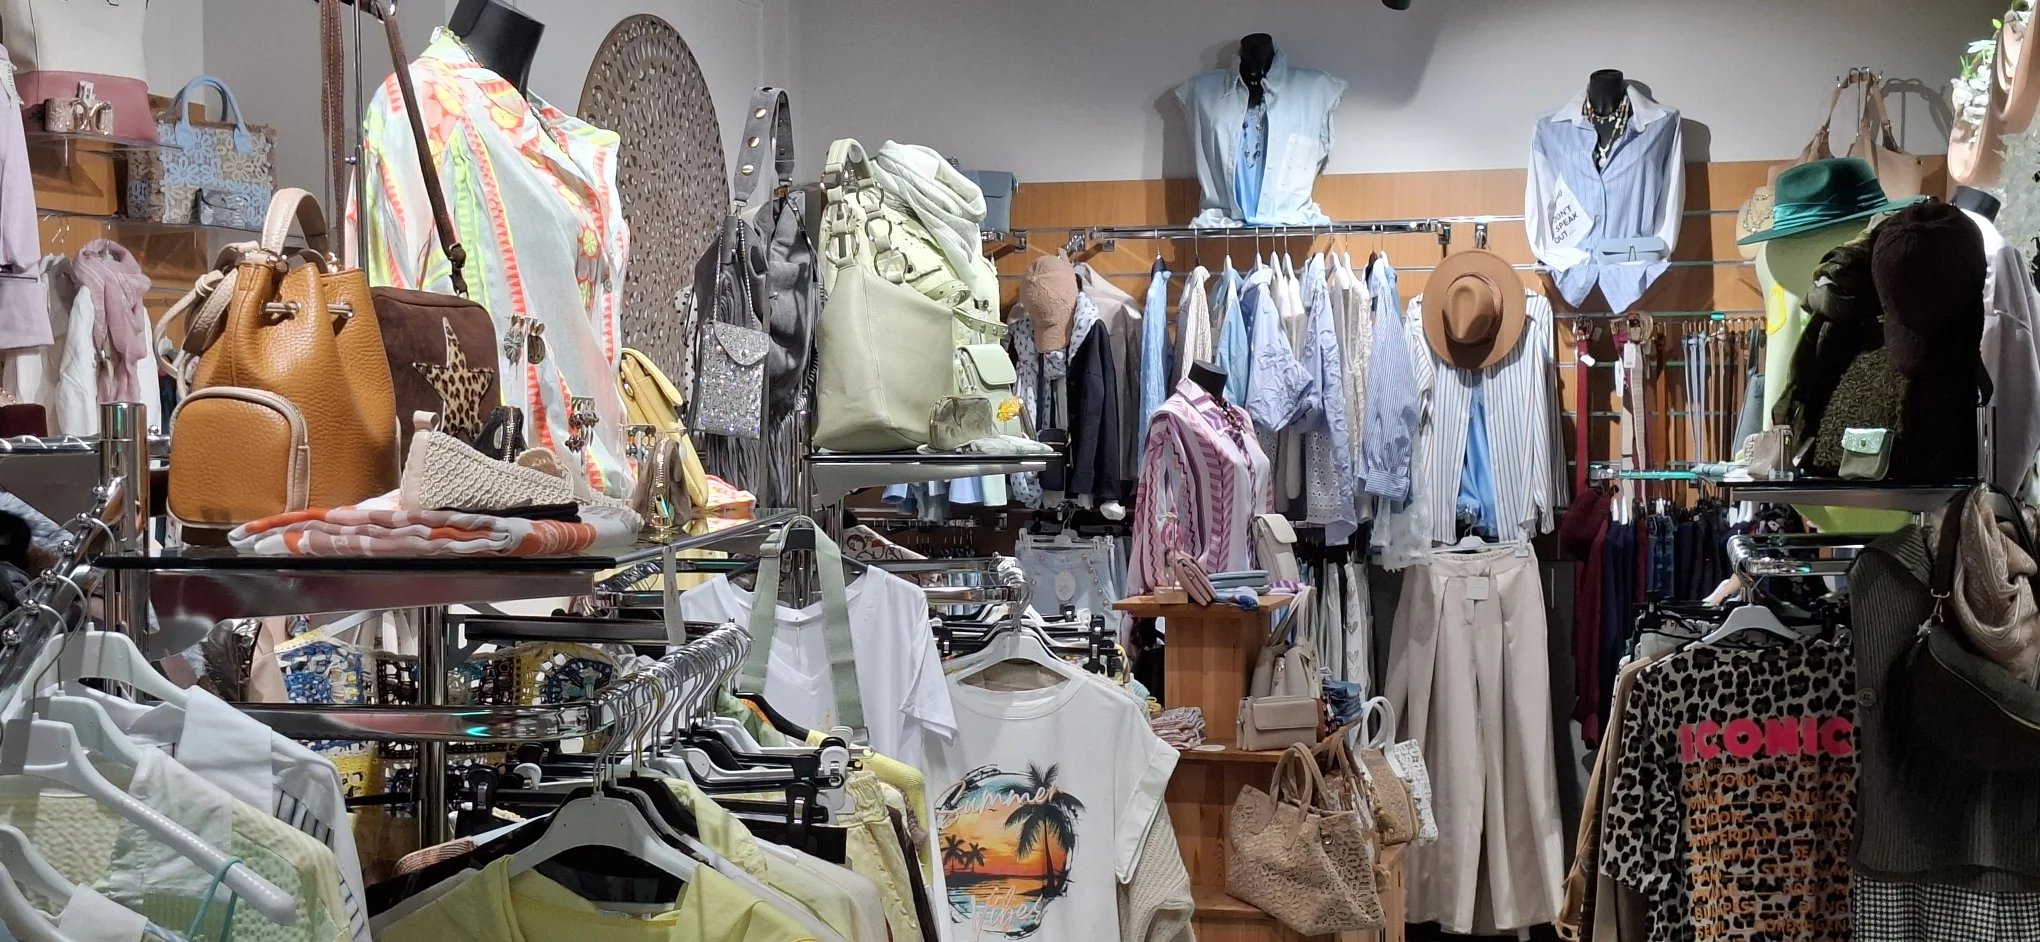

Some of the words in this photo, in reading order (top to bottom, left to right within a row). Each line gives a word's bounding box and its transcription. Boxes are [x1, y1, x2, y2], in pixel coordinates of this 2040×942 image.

[1556, 211, 1578, 232] SPEAK
[1679, 716, 1853, 763] ICONIC
[935, 781, 1058, 829] Summer
[1689, 810, 1745, 829] LONDON
